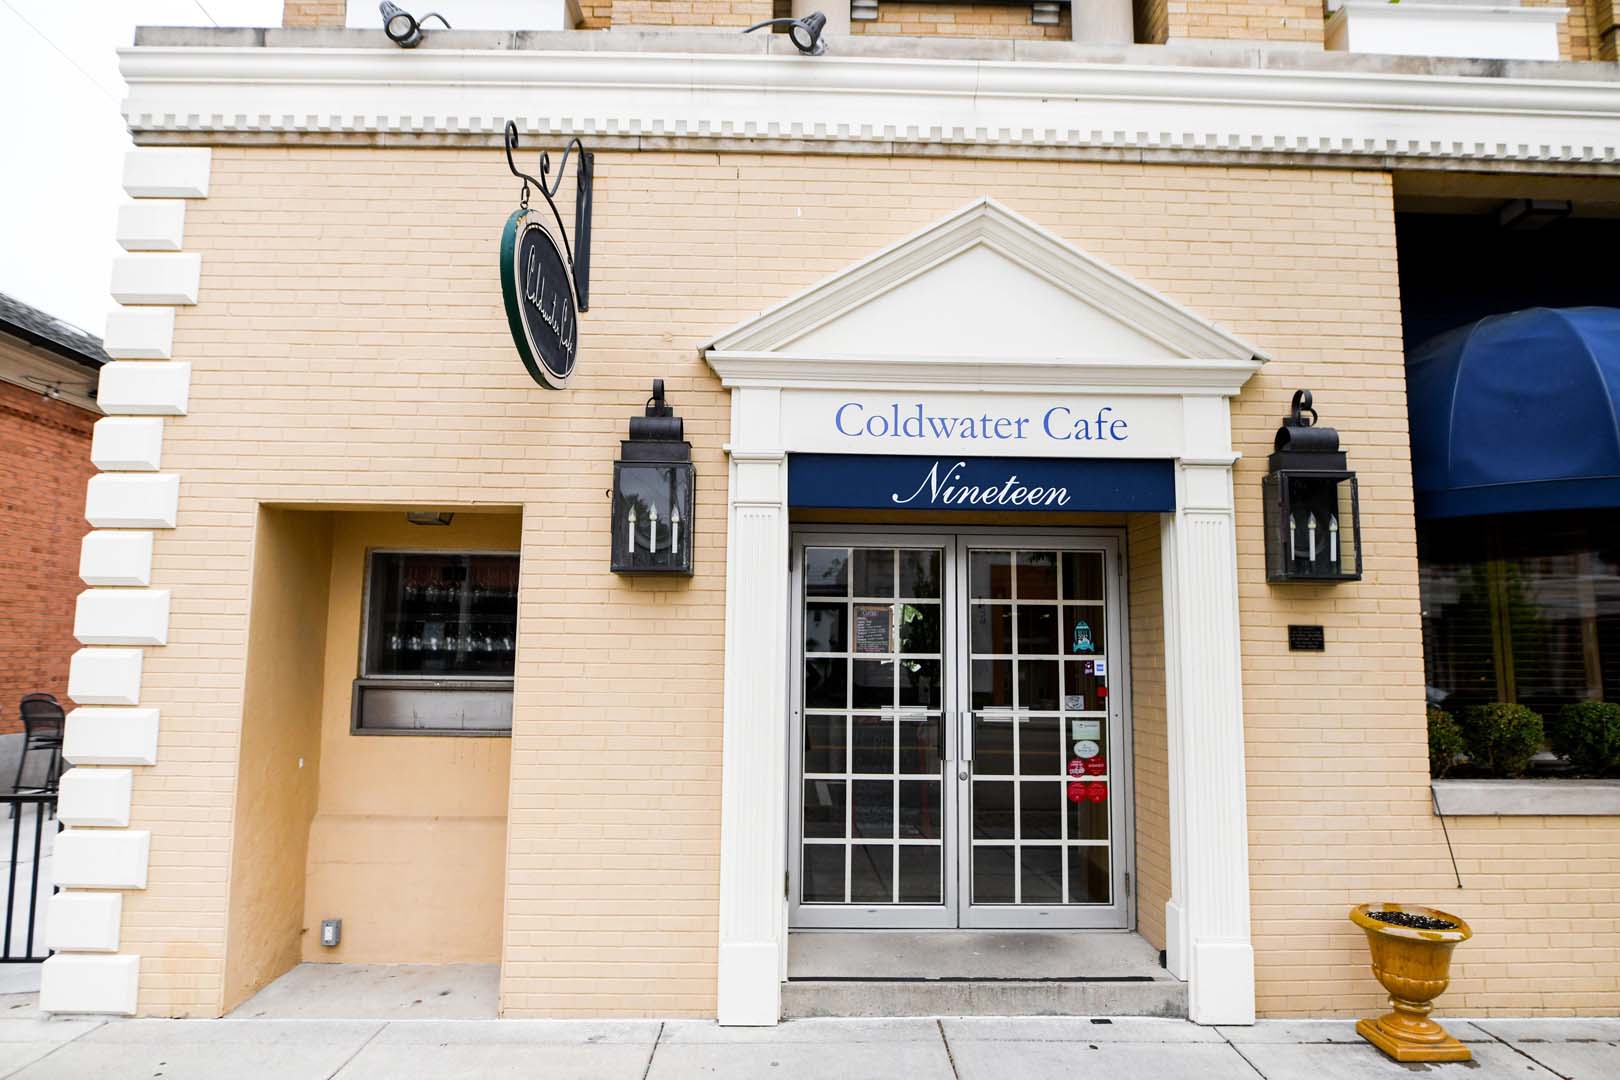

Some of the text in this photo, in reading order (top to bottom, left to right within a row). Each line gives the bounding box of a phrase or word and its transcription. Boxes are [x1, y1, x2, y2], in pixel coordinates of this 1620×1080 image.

[834, 402, 1129, 441] Coldwater Cafe
[891, 460, 1071, 506] Nineteen
